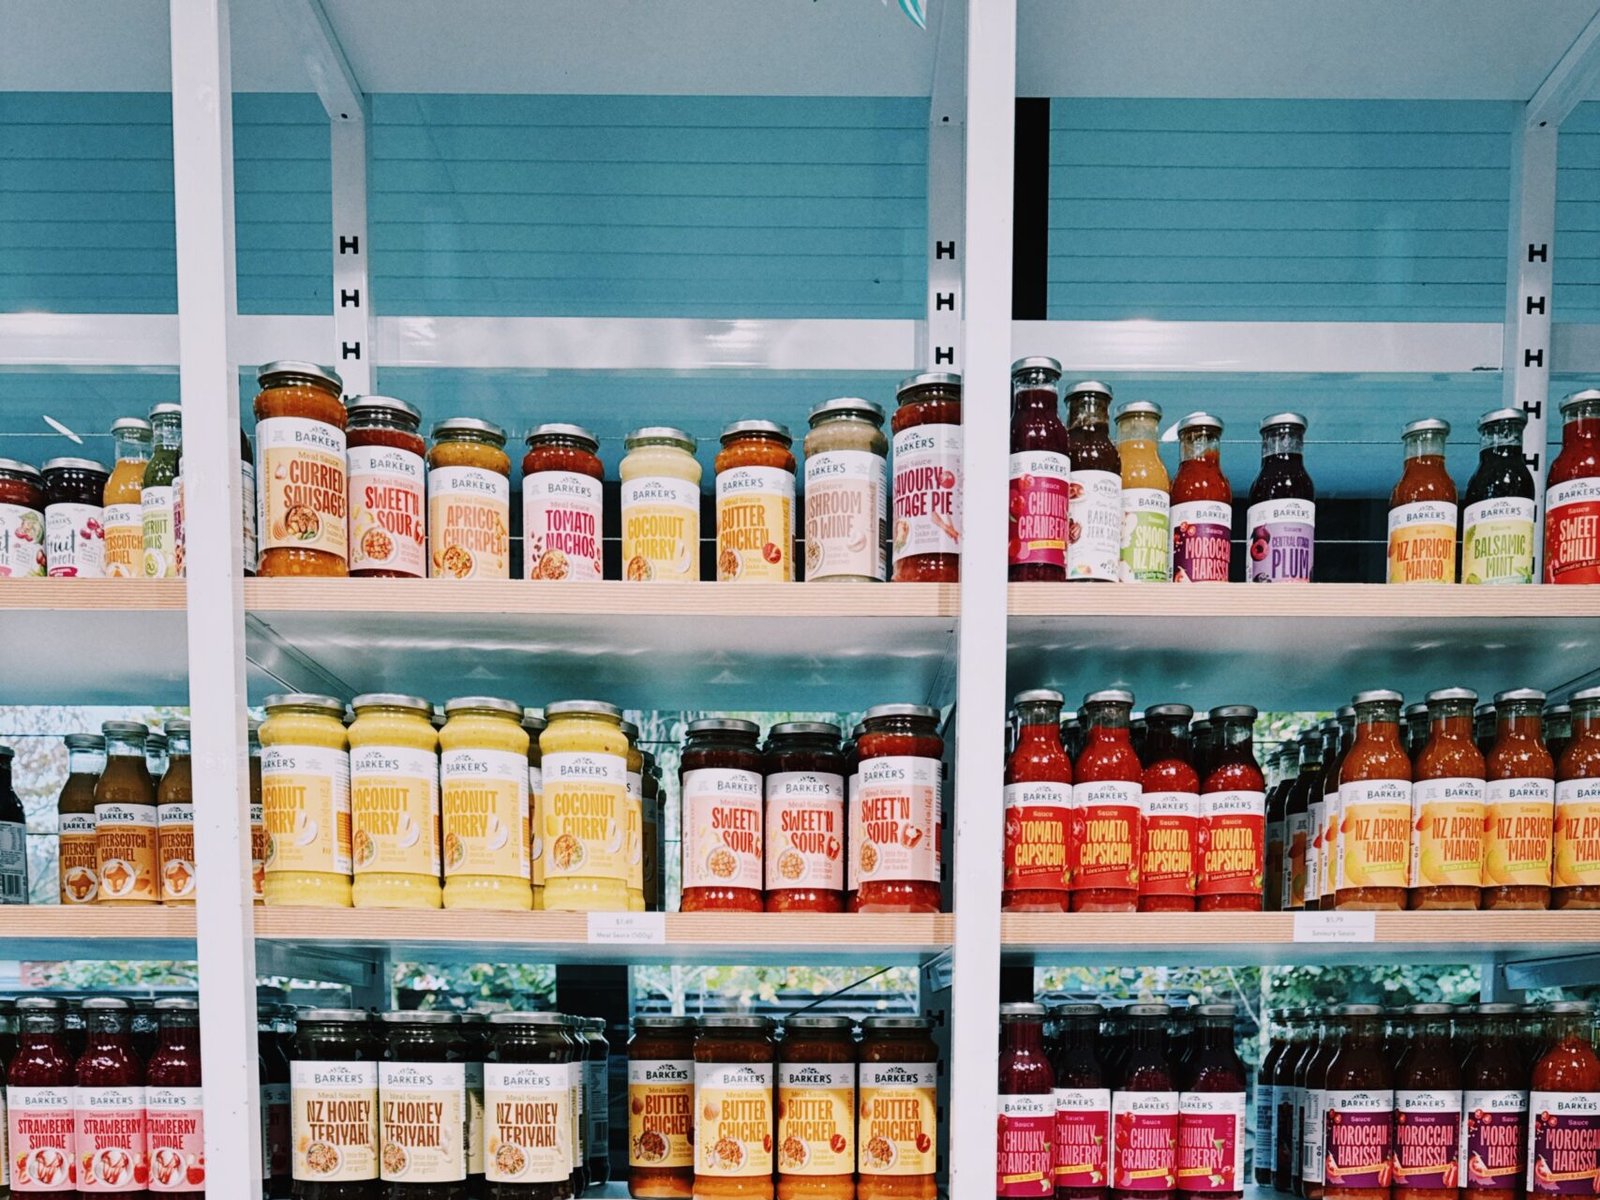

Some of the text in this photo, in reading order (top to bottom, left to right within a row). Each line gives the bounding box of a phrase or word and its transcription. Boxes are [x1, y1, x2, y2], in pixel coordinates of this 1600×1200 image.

[295, 431, 341, 451] BARKER'S
[290, 460, 343, 494] CURRIED
[370, 459, 416, 475] BARKER'S
[284, 485, 346, 518] SAUSAGES
[365, 486, 419, 516] SWEET'N
[548, 483, 592, 498] BARKER'S
[377, 509, 413, 536] SOUR
[546, 509, 595, 535] TOMATO
[627, 516, 685, 539] COCONUT
[722, 505, 765, 528] BUTTER
[1560, 516, 1599, 541] SWEET
[546, 533, 595, 559] NACHOS
[720, 528, 769, 552] CHICKEN
[1412, 539, 1452, 559] APRICOT
[1474, 534, 1525, 559] BALSAMIC
[1560, 539, 1596, 562] CHILLI
[1272, 549, 1309, 578] PLUM
[1405, 560, 1444, 580] MANGO
[1486, 556, 1514, 577] MINT
[560, 765, 608, 777] BARKER'S
[786, 783, 830, 793] BARKER'S
[1023, 792, 1062, 802] BARKER'S
[554, 793, 616, 818] COCONUT
[861, 796, 910, 822] SWEET'N
[562, 818, 608, 840] CURRY
[781, 810, 834, 831] SWEET'N
[1086, 819, 1129, 843] TOMATO
[790, 832, 825, 854] SOUR
[866, 822, 899, 844] SOUR
[1021, 820, 1063, 844] TOMATO
[1210, 828, 1253, 851] TOMATO
[1015, 843, 1066, 867] CAPSICUM
[1080, 842, 1132, 866] CAPSICUM
[1204, 849, 1256, 872] CAPSICUM
[1366, 840, 1404, 862] MANGO
[1508, 839, 1546, 861] MANGO
[314, 1073, 363, 1085] BARKER'S
[646, 1069, 688, 1080] BARKER'S
[875, 1073, 918, 1083] BARKER'S
[306, 1100, 370, 1122] NZ HONEY
[496, 1102, 558, 1125] NZ HONEY
[645, 1095, 690, 1116] BUTTER
[722, 1100, 766, 1120] BUTTER
[873, 1099, 920, 1120] BUTTER
[84, 1119, 141, 1135] STRAWBERRY
[310, 1123, 369, 1145] TERIYAKI
[499, 1126, 556, 1148] TERIYAKI
[718, 1121, 768, 1142] CHICKEN
[871, 1120, 923, 1141] CHICKEN
[1333, 1125, 1387, 1145] MOROCCAN
[95, 1135, 131, 1150] SUNDAE
[1131, 1128, 1171, 1149] CHUNKY
[1122, 1148, 1175, 1169] CRANBERRY
[1339, 1145, 1381, 1166] HARISSA
